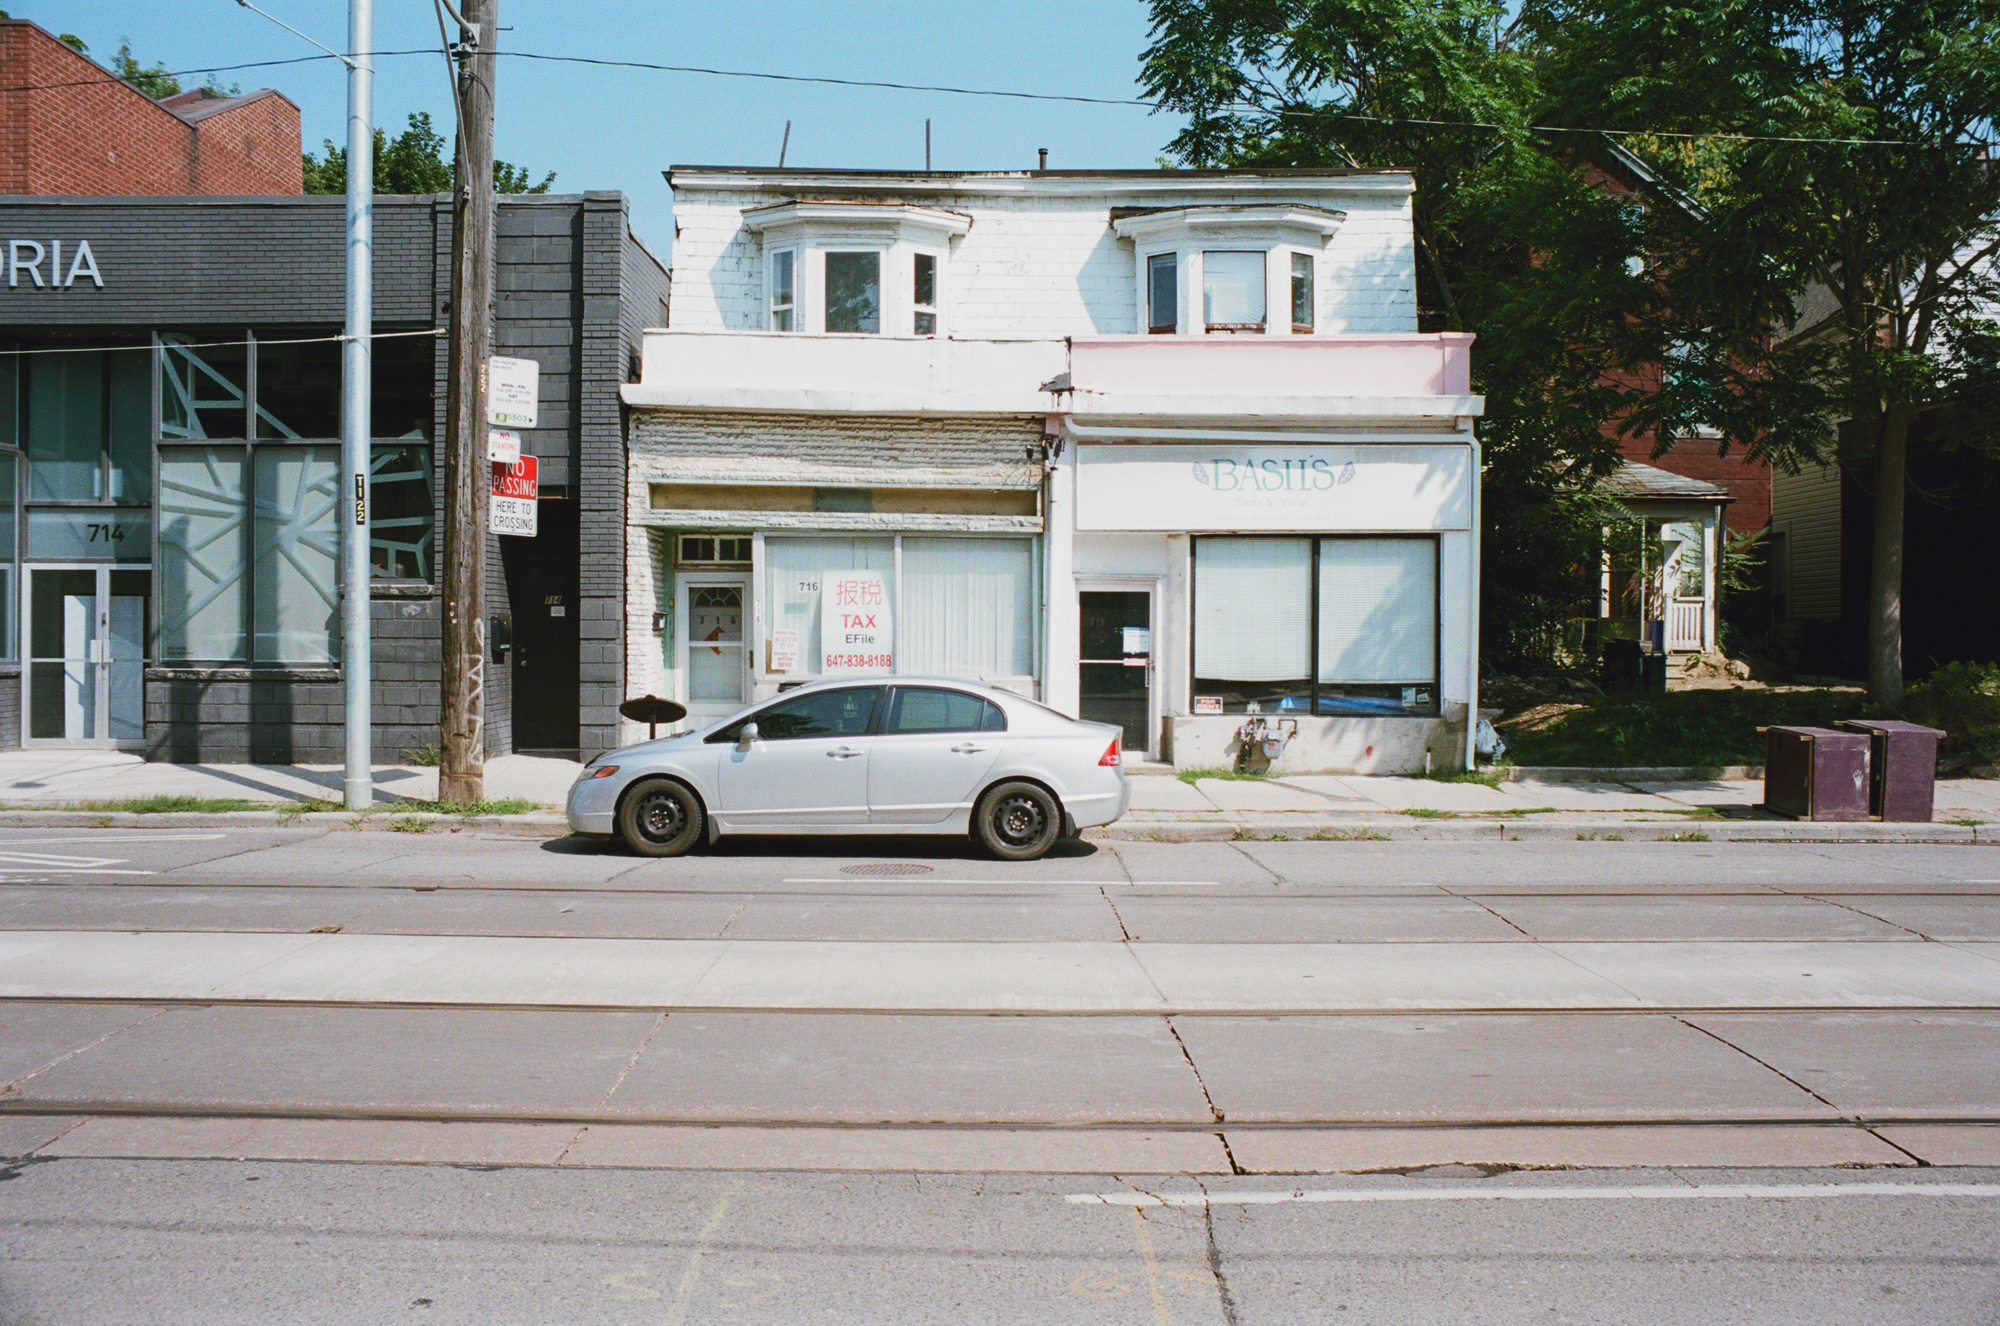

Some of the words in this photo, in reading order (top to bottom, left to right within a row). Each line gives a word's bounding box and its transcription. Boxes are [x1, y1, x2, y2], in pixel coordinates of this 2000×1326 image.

[0, 239, 104, 288] RIA
[500, 432, 510, 441] NO
[491, 441, 518, 453] STANDING
[506, 460, 525, 477] NO
[493, 475, 536, 497] PASSING
[356, 476, 365, 522] T122
[496, 500, 517, 514] HERE
[522, 503, 532, 516] TO
[493, 515, 534, 531] CROSSING
[87, 524, 126, 542] 714
[800, 582, 819, 592] 716
[836, 580, 882, 606] 报税
[841, 614, 877, 629] TAX
[845, 634, 875, 644] EFile
[826, 654, 892, 668] 647-838-8188
